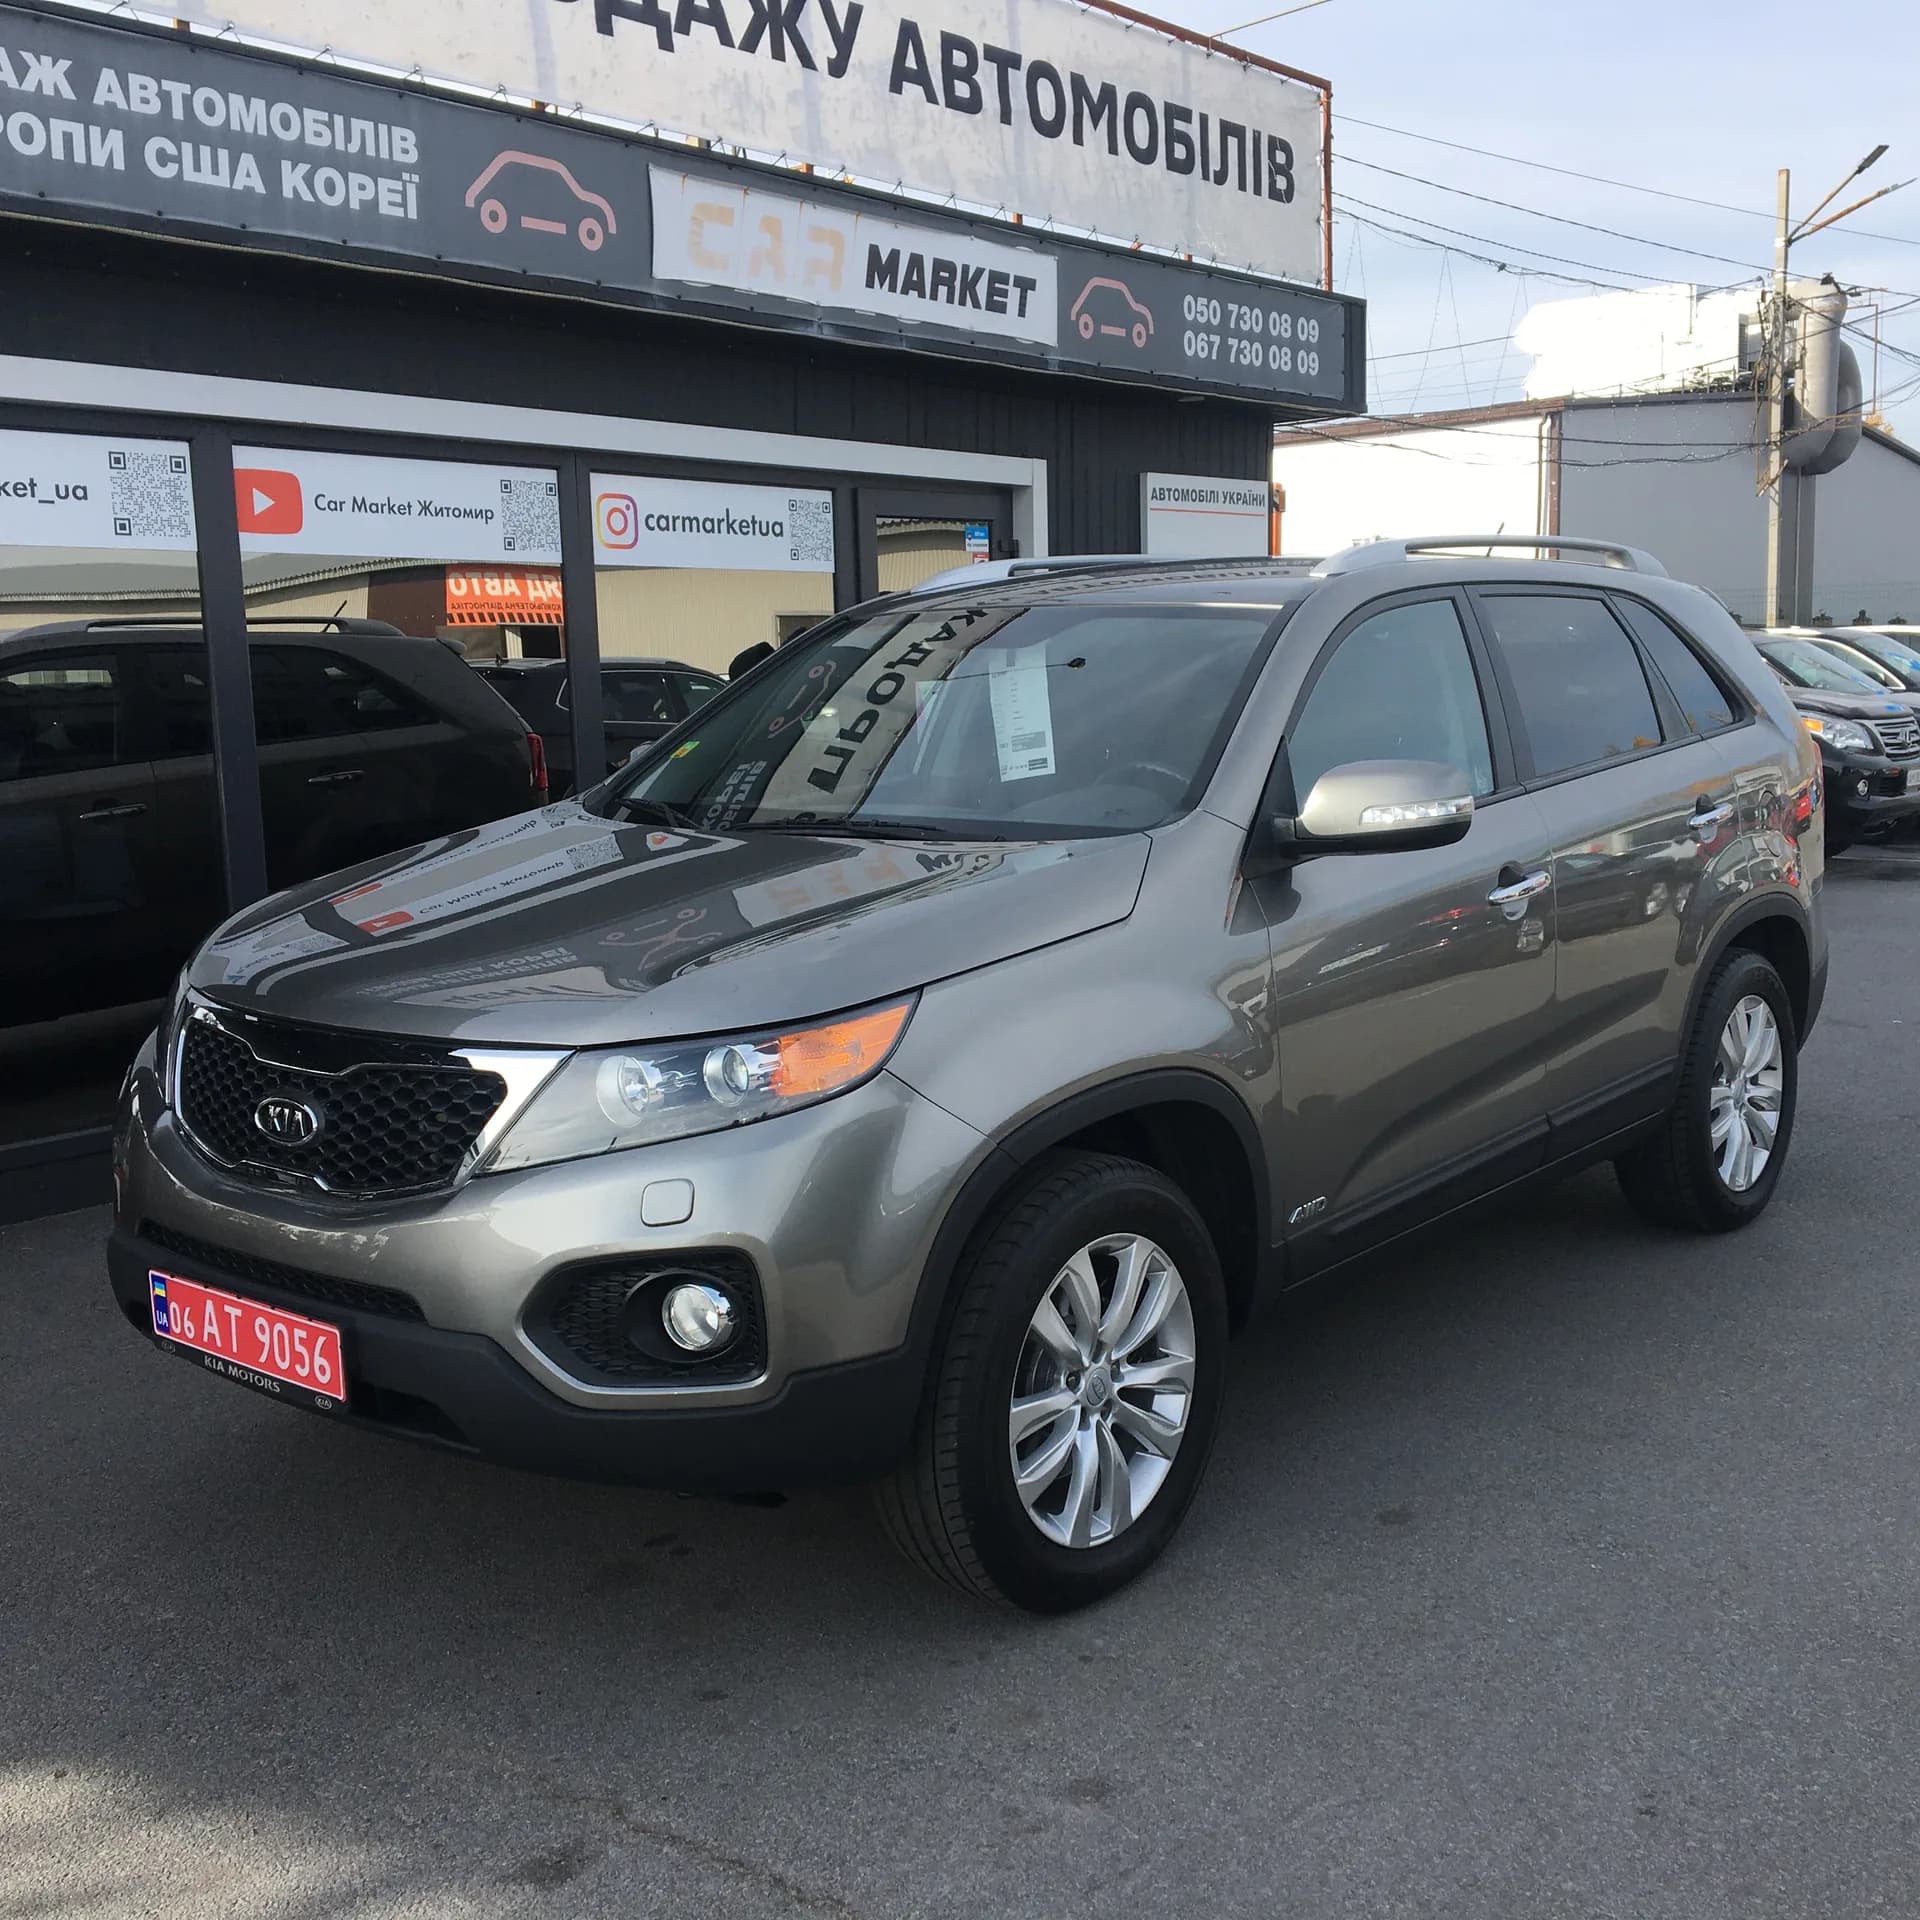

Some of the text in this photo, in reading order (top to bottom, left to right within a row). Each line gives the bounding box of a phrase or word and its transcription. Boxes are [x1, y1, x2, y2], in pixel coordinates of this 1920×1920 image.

[93, 67, 419, 164] АВТОМОБІЛІВ
[889, 18, 1296, 204] АВТОМОБІЛІВ
[0, 111, 420, 220] ОПИ США КОРЕЇ
[864, 243, 1037, 319] MARKET
[1183, 294, 1320, 344] 050 730 08 09
[1183, 330, 1320, 376] 067 730 08 09
[314, 493, 495, 525] Car Market Житомир
[1151, 487, 1265, 507] АВТОМОБІЛІ УКРАЇНИ
[644, 508, 784, 538] carmarketua
[267, 1104, 306, 1137] KIA
[156, 1309, 169, 1328] UA
[169, 1299, 332, 1384] 06 AT 9056
[204, 1355, 281, 1393] KIA MOTORS
